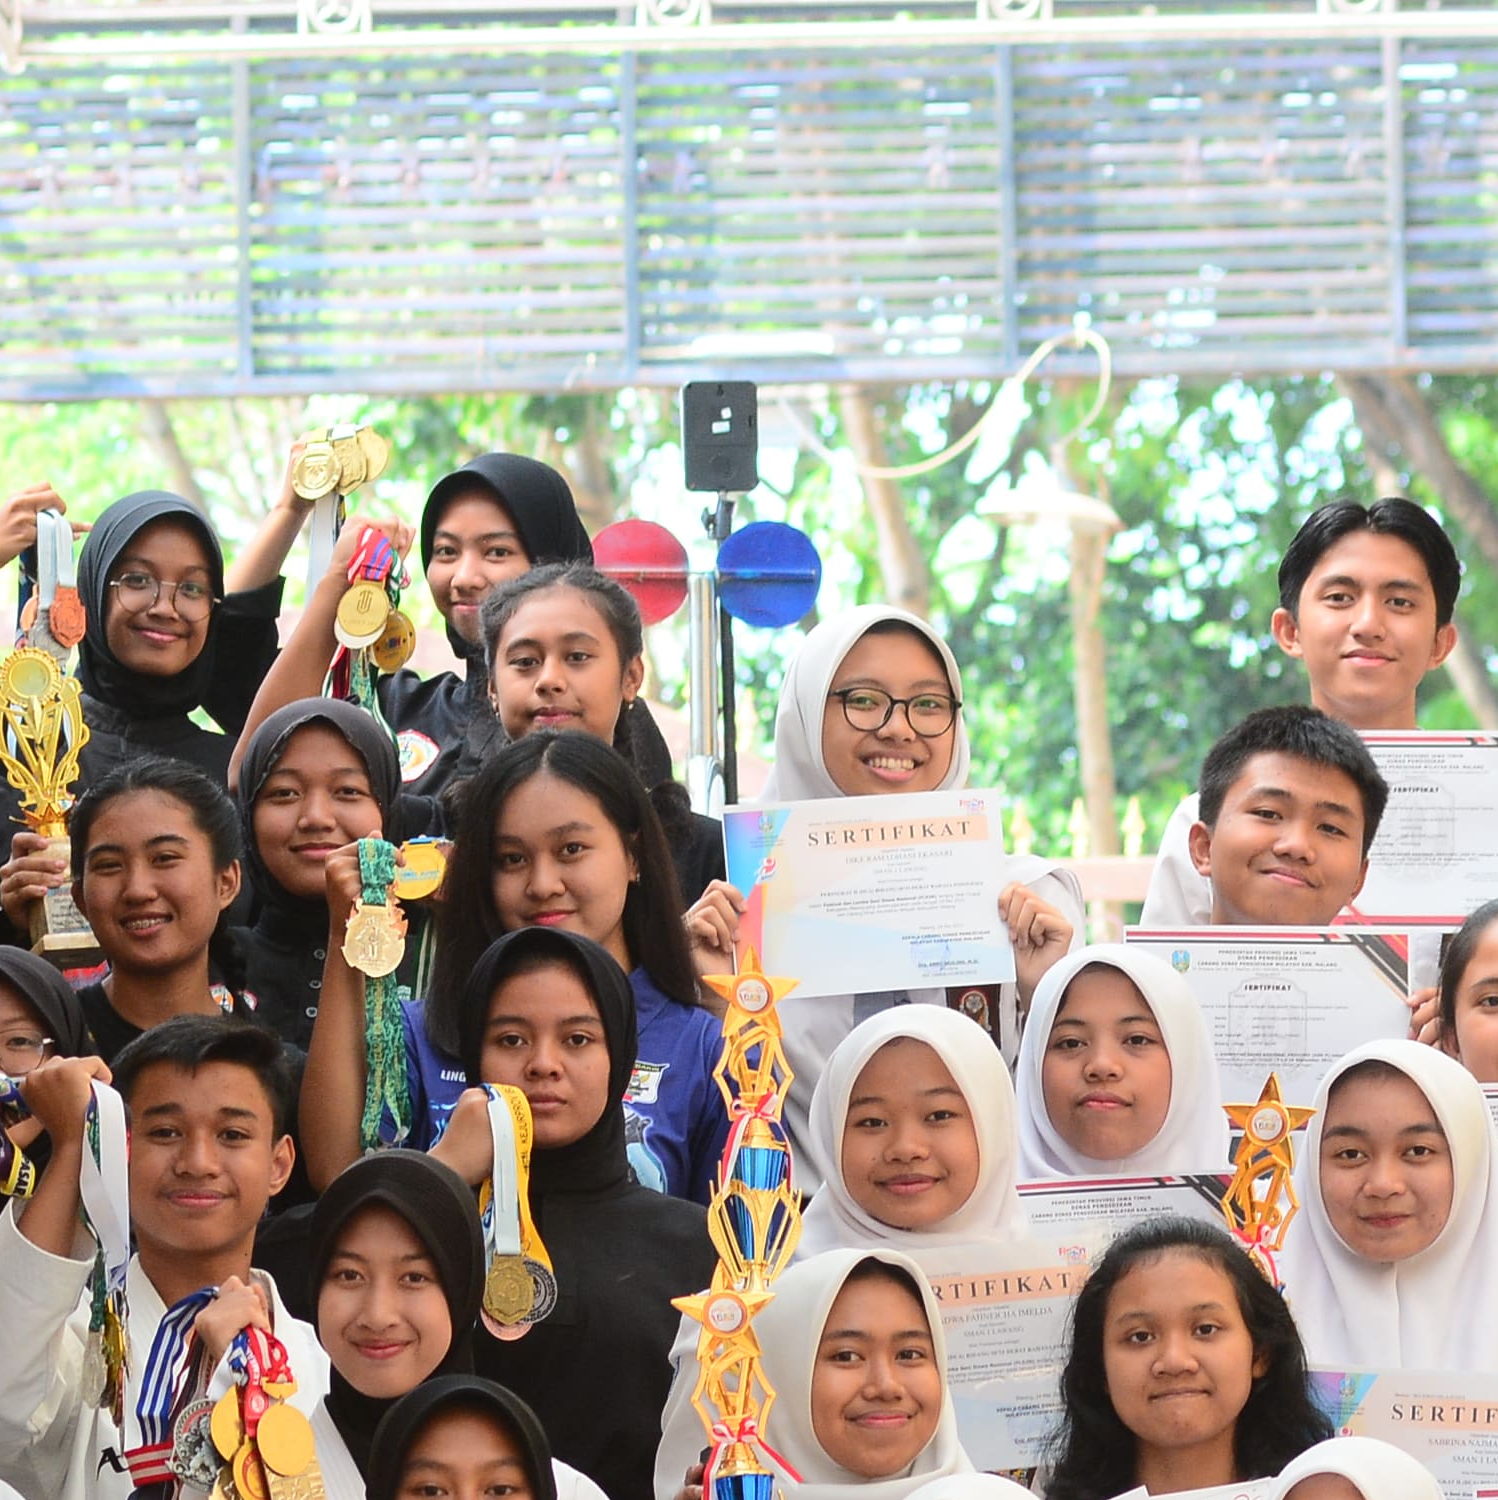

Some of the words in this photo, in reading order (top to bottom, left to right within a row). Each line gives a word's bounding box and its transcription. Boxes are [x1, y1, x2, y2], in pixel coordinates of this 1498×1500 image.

[808, 820, 971, 848] SERTIFIKAT
[1244, 984, 1292, 992] SERTIFIKAT
[14, 1158, 35, 1196] PASAR
[932, 1272, 1071, 1301] RTIFIKAT
